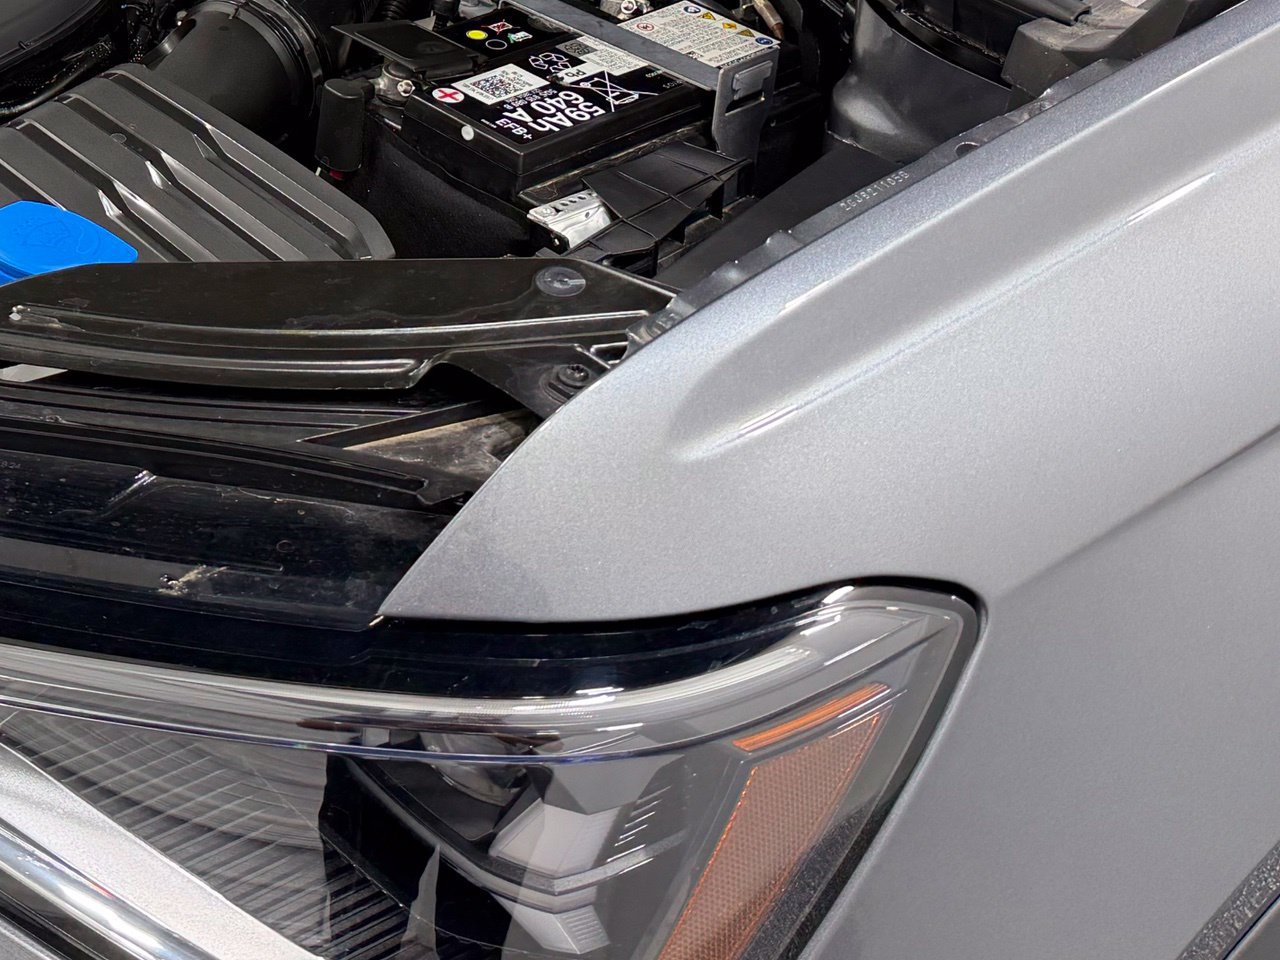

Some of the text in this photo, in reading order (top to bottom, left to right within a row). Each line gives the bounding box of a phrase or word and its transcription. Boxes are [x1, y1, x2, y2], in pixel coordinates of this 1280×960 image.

[564, 68, 587, 79] Pb
[530, 90, 585, 115] 640
[502, 107, 534, 123] A
[527, 101, 606, 132] 59Ah
[495, 117, 533, 140] EFB+
